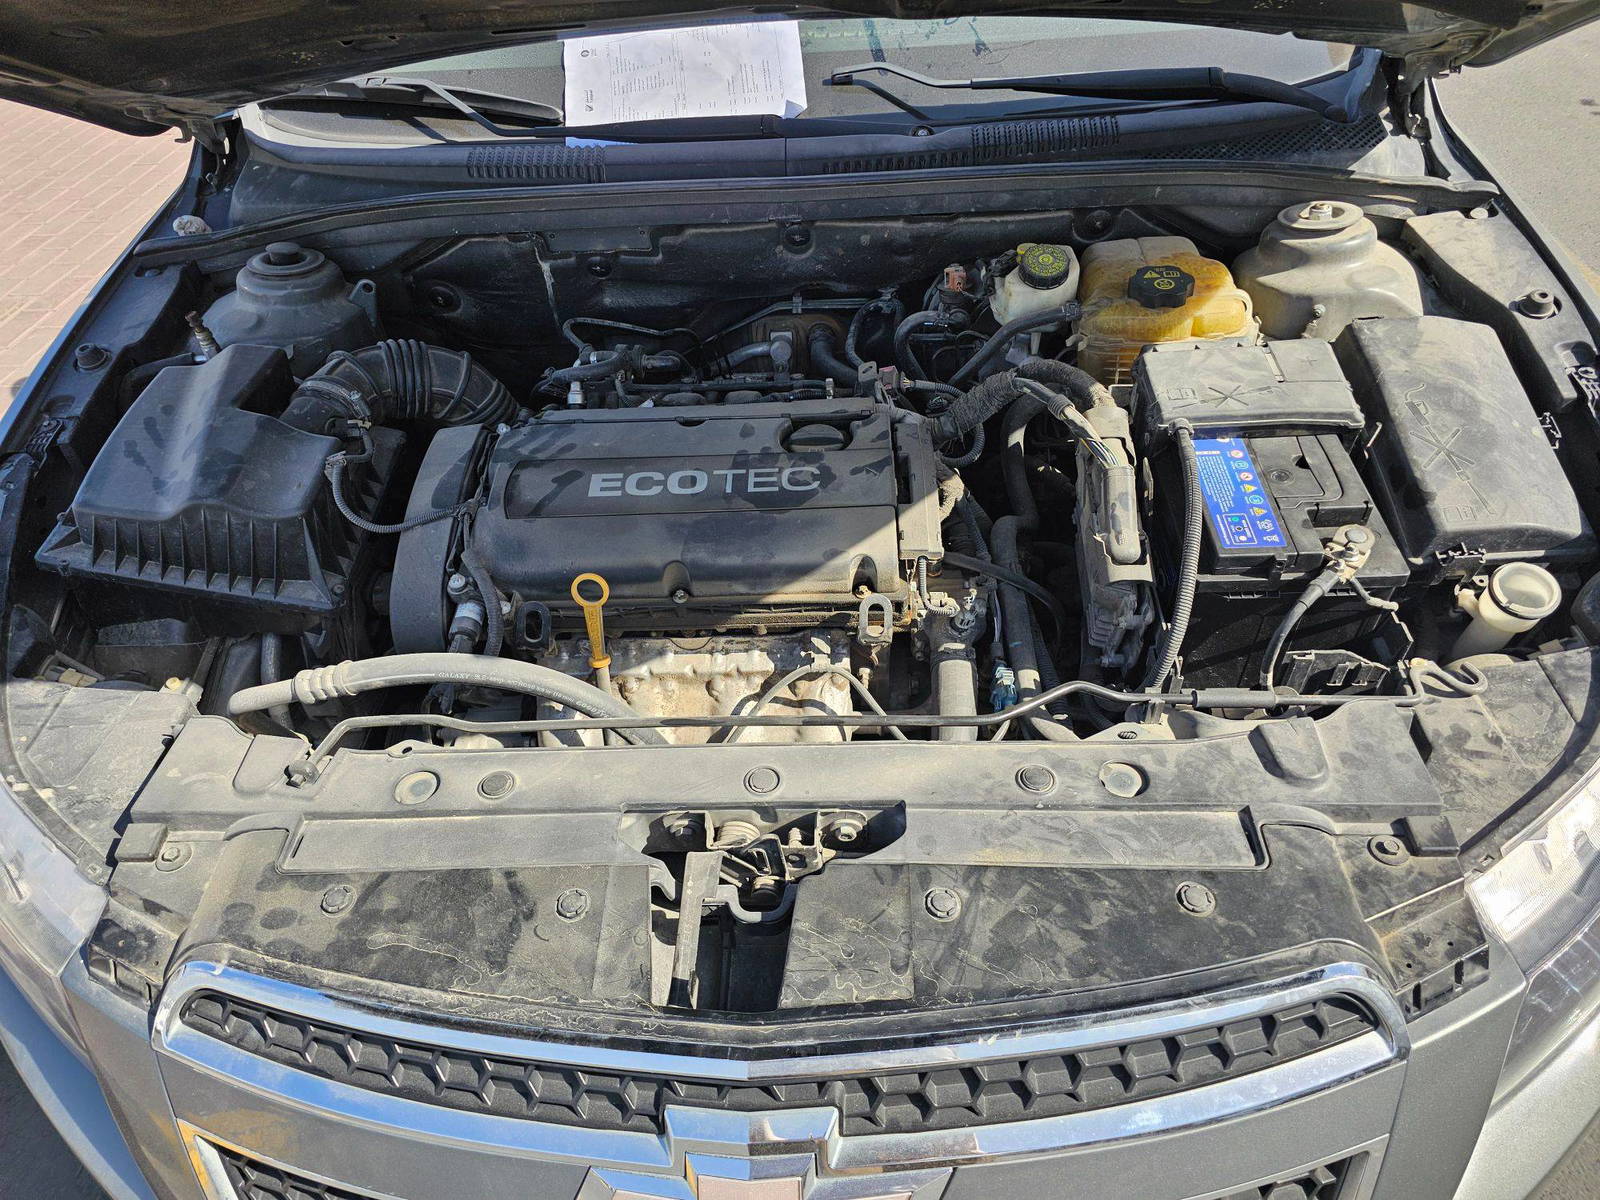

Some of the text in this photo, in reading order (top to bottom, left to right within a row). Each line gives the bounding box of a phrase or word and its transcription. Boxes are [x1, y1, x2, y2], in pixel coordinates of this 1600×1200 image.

[587, 466, 821, 498] ECOTEC
[438, 671, 471, 680] GALAXY
[575, 701, 611, 719] GOODYE
